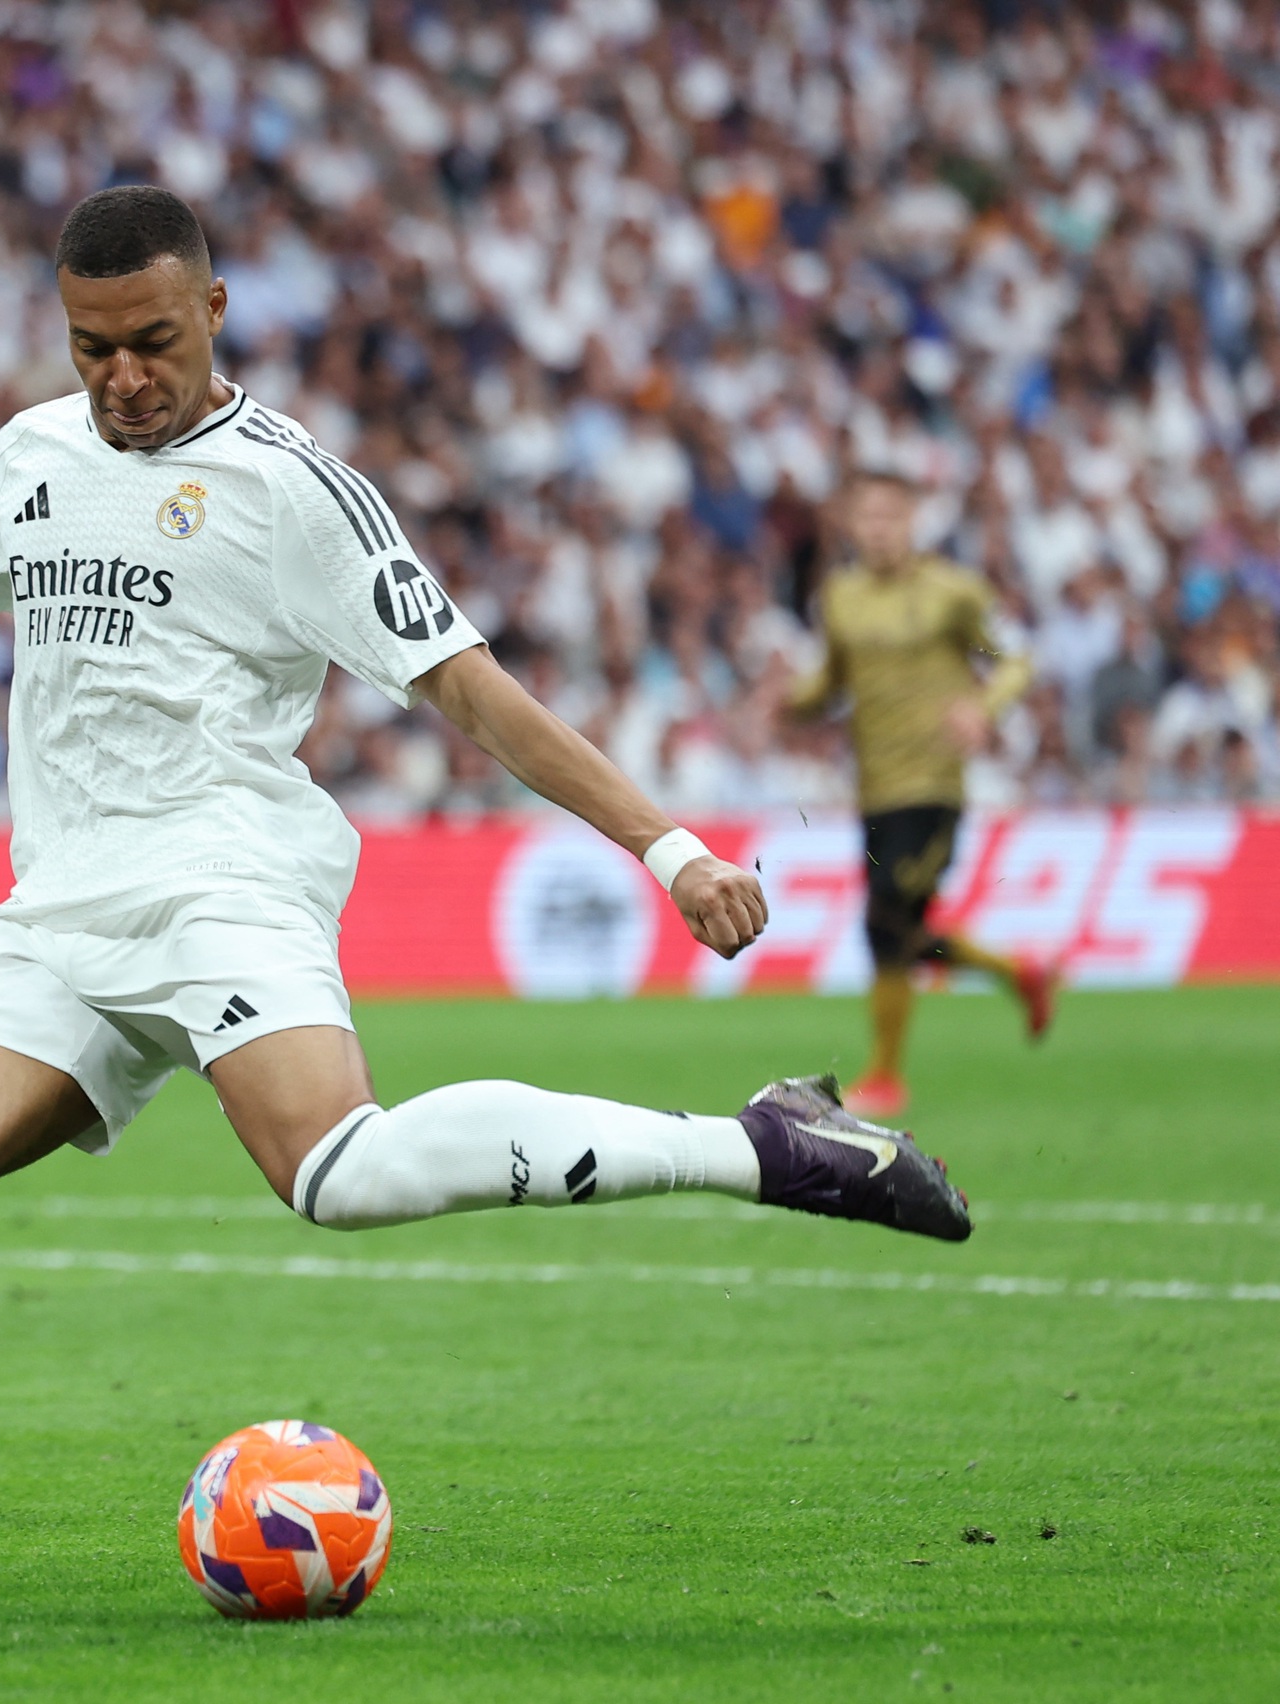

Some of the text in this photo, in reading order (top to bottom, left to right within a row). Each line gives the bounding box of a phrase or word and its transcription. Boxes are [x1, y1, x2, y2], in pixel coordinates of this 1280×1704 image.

[9, 548, 174, 607] Emirates
[379, 559, 447, 640] hp
[28, 605, 134, 647] FLY BETTER
